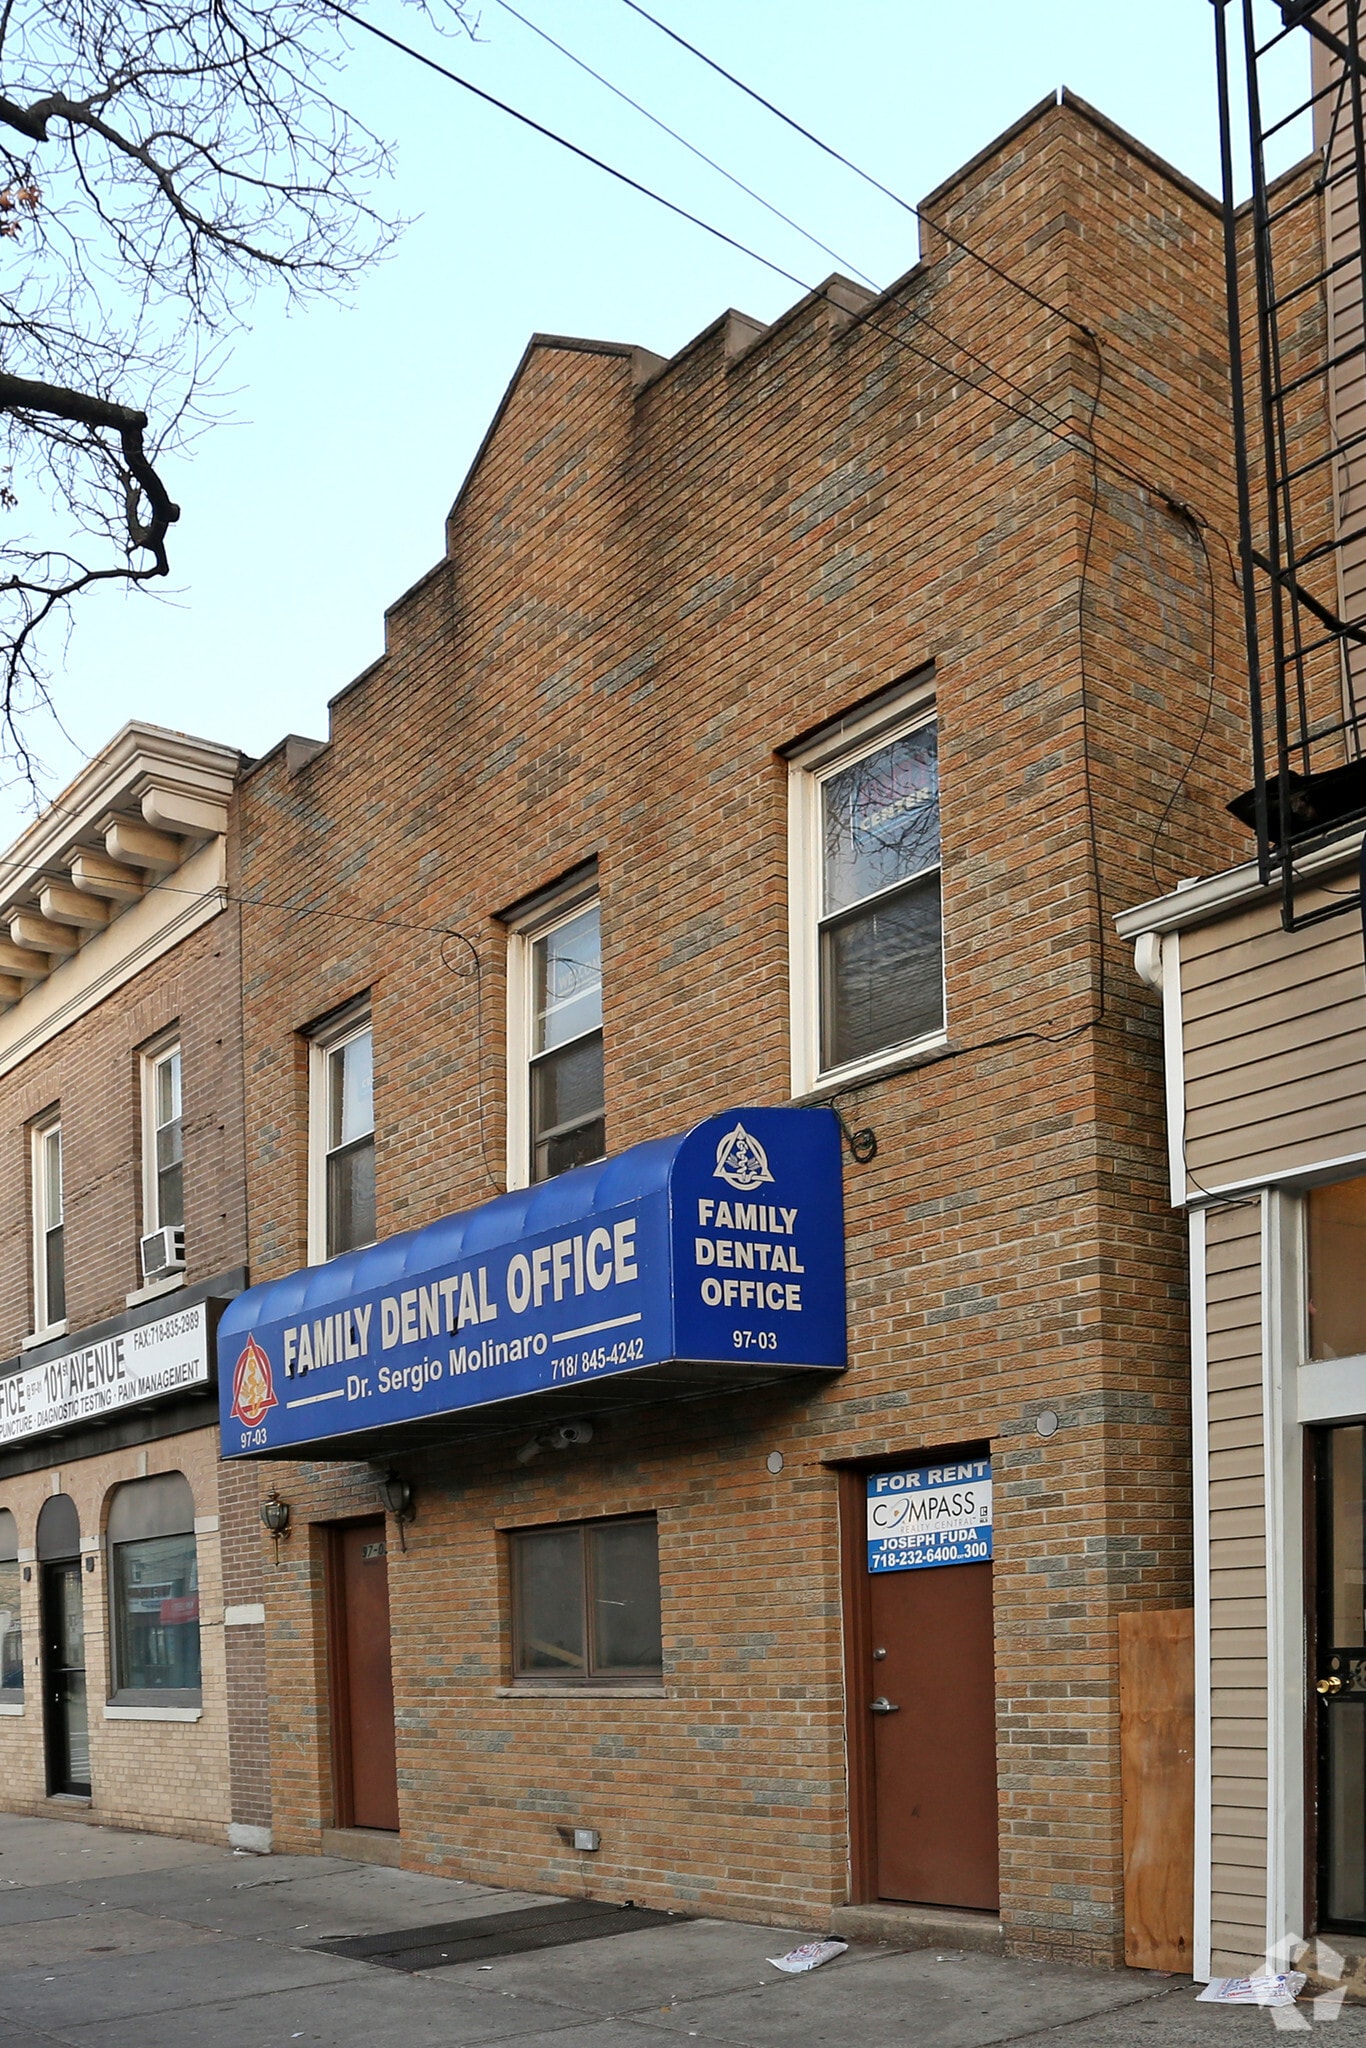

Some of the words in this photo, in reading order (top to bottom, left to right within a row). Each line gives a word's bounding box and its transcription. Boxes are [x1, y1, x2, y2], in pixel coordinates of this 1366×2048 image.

[860, 786, 930, 831] CENTER
[698, 1198, 798, 1235] FAMILY
[694, 1237, 805, 1274] DENTAL
[282, 1303, 372, 1378] FAMILY
[381, 1266, 497, 1350] DENTAL
[505, 1217, 639, 1314] OFFICE
[700, 1277, 803, 1312] OFFICE
[732, 1330, 778, 1350] 97-03
[69, 1339, 125, 1397] AVENUE
[346, 1373, 372, 1402] Dr.
[377, 1355, 443, 1394] Sergio
[448, 1332, 548, 1375] Molinaro
[550, 1353, 577, 1381] 718/
[581, 1337, 645, 1373] 845-4242
[37, 1400, 79, 1427] DIAGNOSTIC
[80, 1388, 112, 1413] TESTING
[118, 1382, 137, 1402] PAIN
[138, 1359, 200, 1395] MANAGEMENT
[240, 1427, 268, 1450] 97-03
[876, 1472, 921, 1492] FOR
[927, 1461, 988, 1485] RENT
[873, 1491, 975, 1528] COMPASS
[900, 1522, 930, 1534] REALTY
[935, 1517, 973, 1531] CENTRAL
[872, 1545, 957, 1569] 718-232-6400
[963, 1542, 988, 1558] 300
[879, 1534, 936, 1551] JOSEPH
[940, 1529, 978, 1544] FUDA
